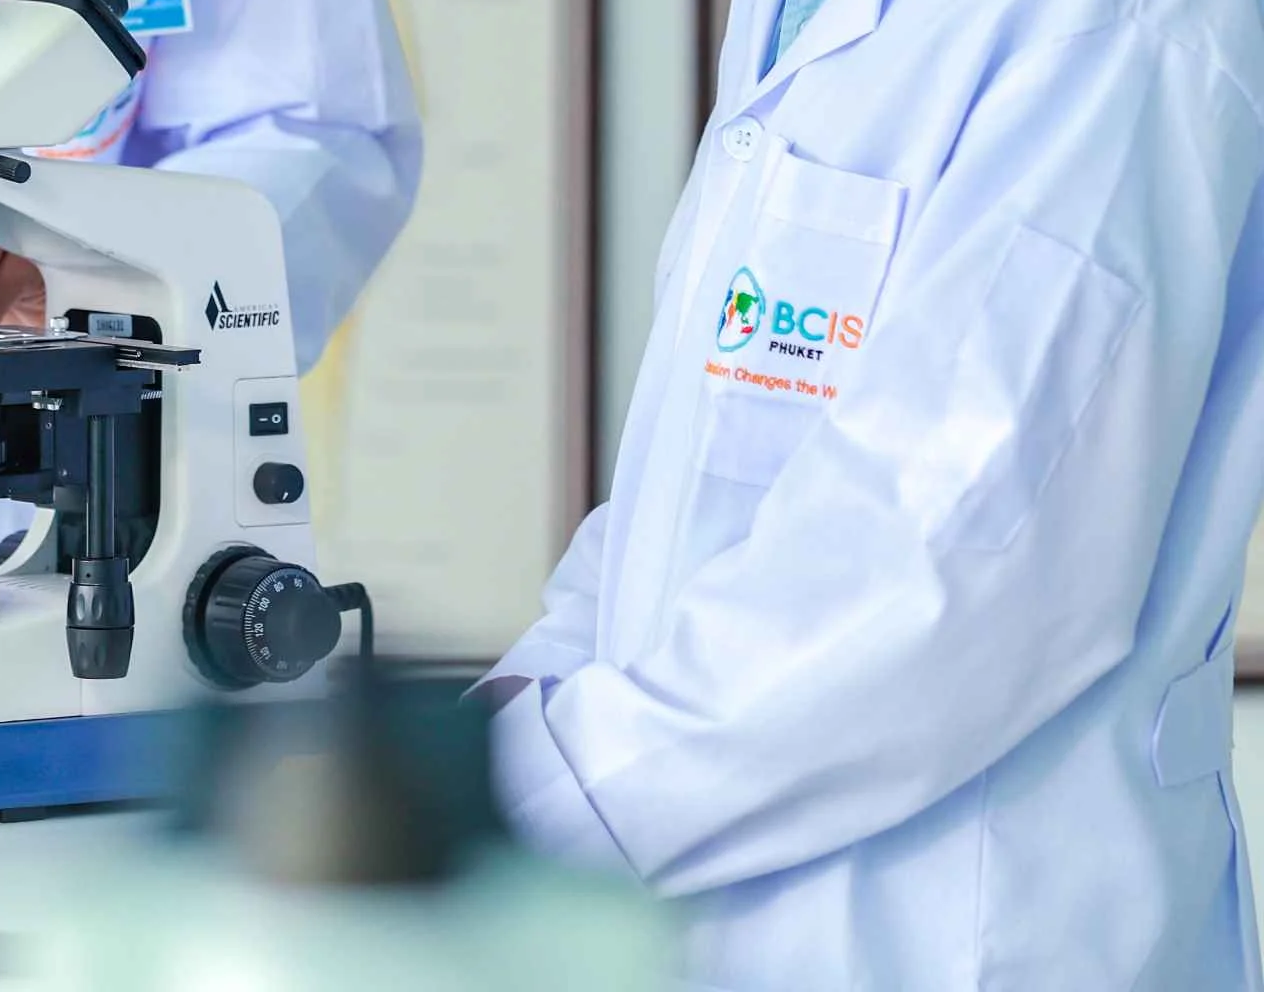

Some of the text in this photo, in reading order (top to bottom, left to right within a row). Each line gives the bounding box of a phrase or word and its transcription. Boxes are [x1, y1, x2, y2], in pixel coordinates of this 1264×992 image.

[219, 311, 280, 329] SCIENTIFIC
[771, 299, 864, 349] BCIS
[769, 341, 824, 361] PHUKET
[735, 368, 791, 390] Changes
[796, 379, 817, 395] the
[258, 597, 271, 612] 100
[255, 623, 265, 637] 120
